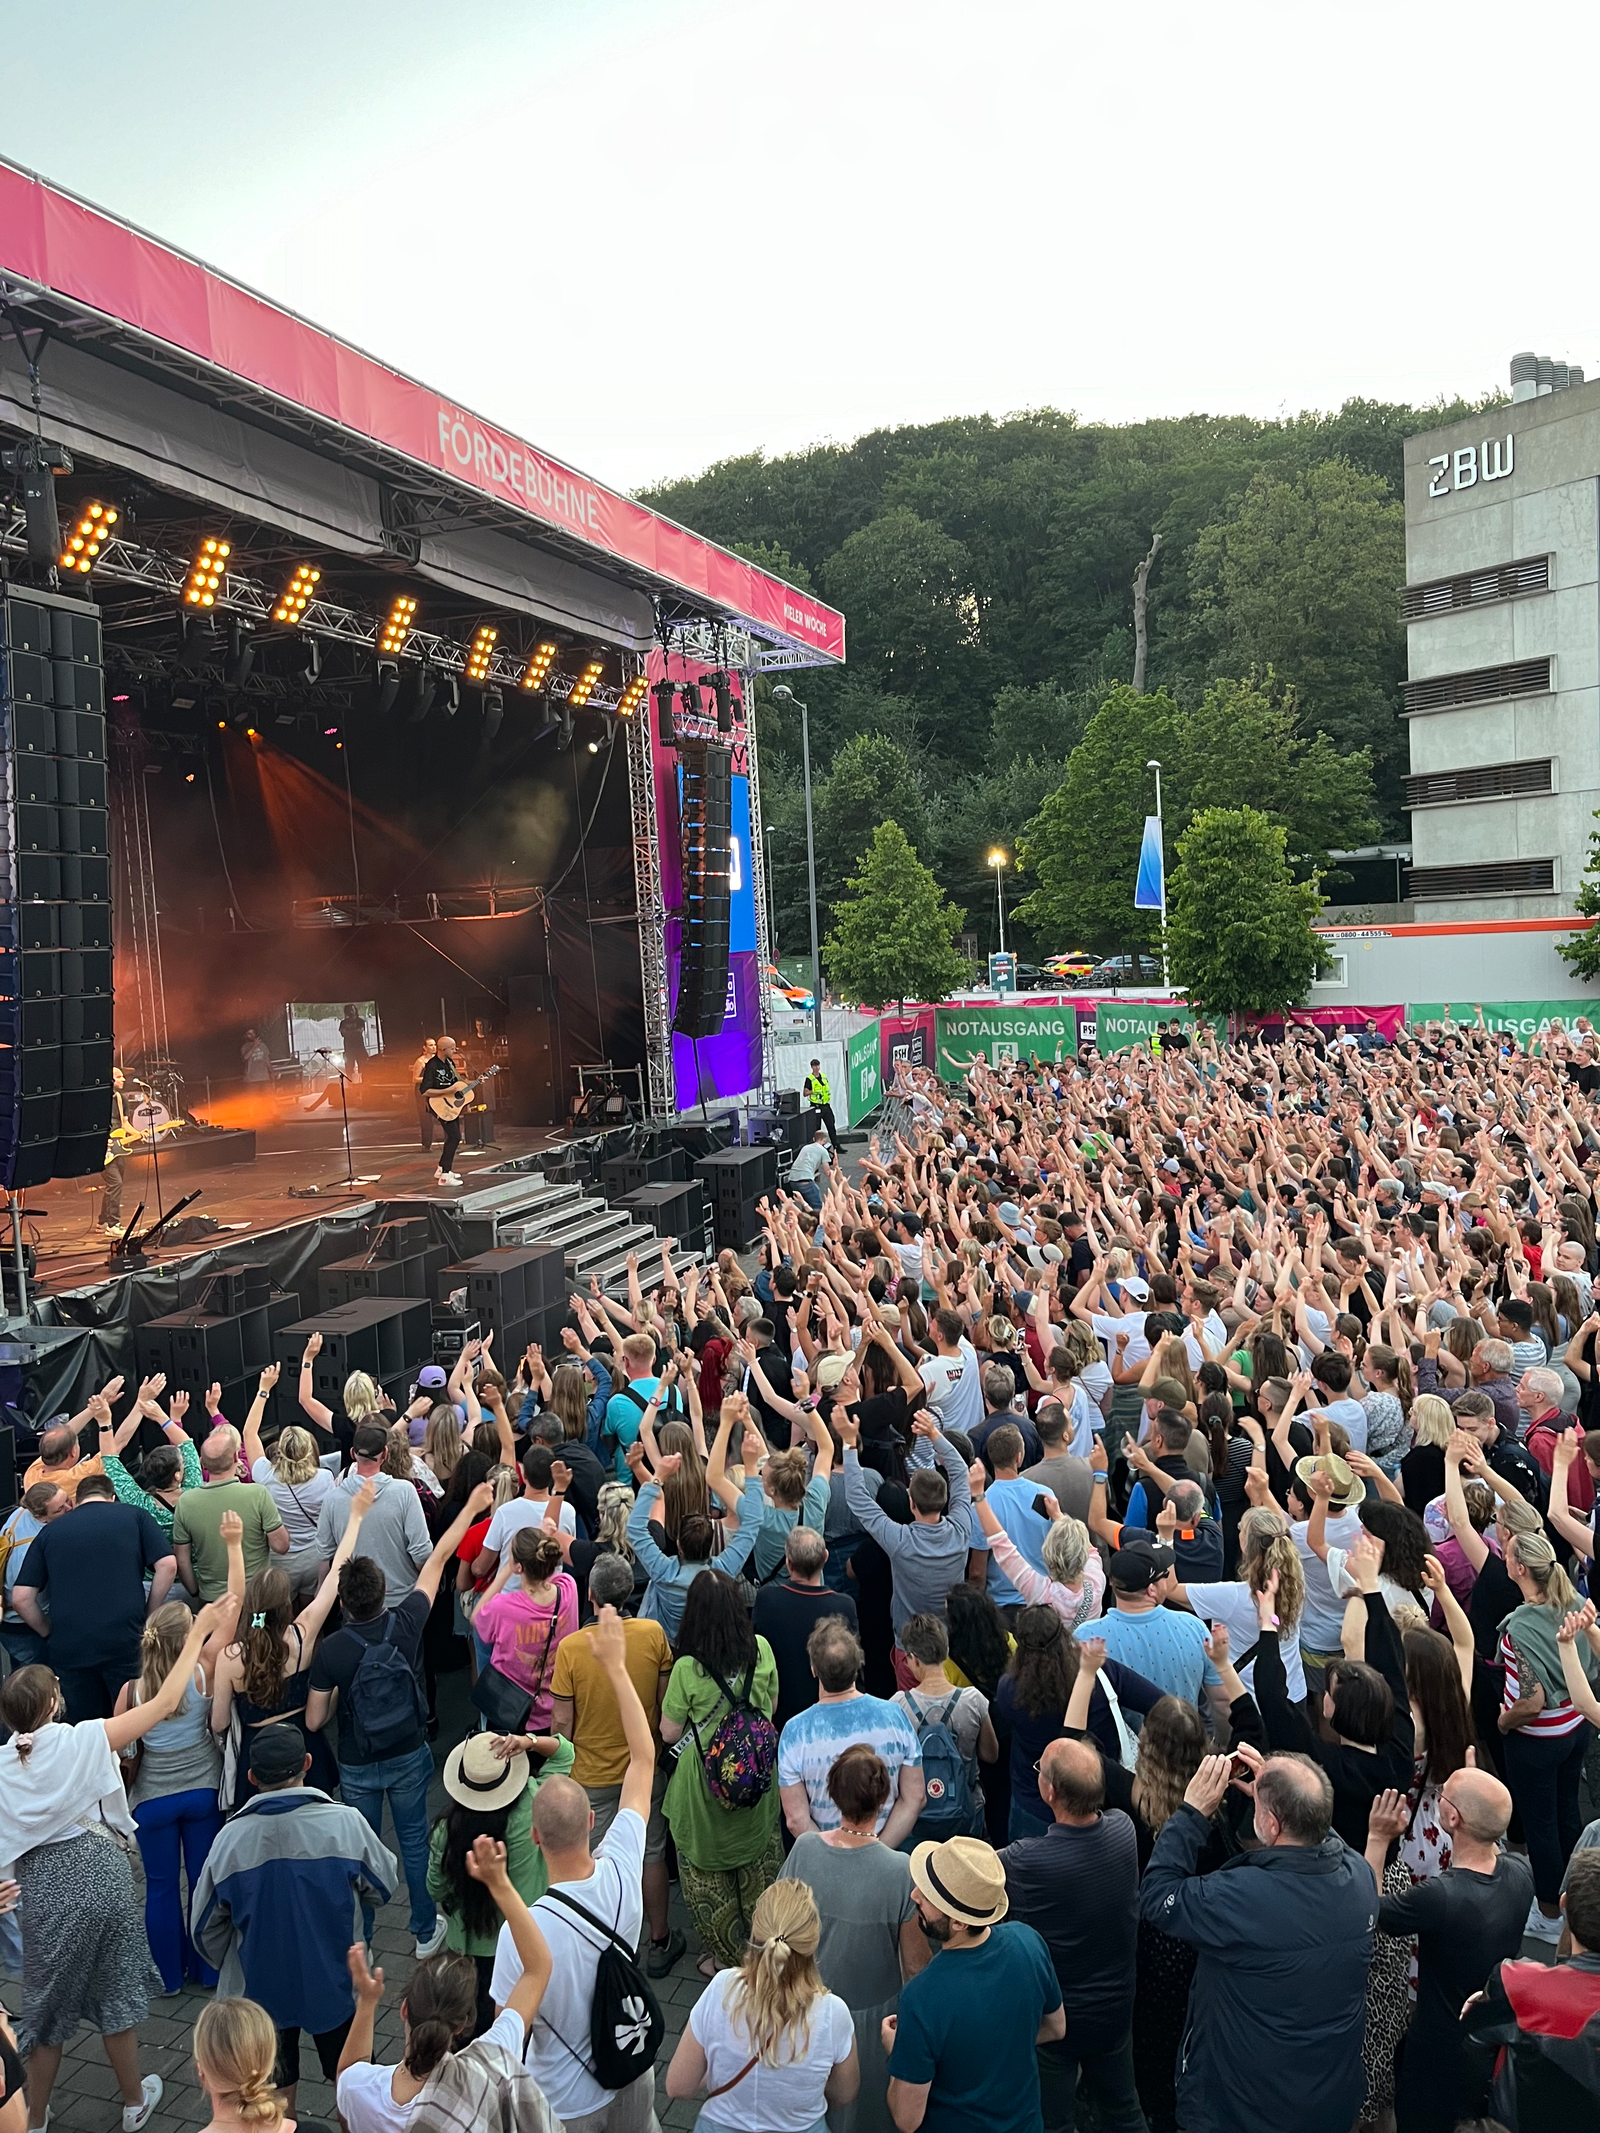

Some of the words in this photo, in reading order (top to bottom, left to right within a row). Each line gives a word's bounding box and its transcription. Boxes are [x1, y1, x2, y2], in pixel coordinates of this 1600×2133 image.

[437, 411, 600, 530] FÖRDEBÜHNE
[1428, 433, 1515, 498] ZBW
[783, 602, 804, 627] KIELER
[804, 613, 828, 637] WOCHE
[946, 1020, 1065, 1036] NOTAUSGANG
